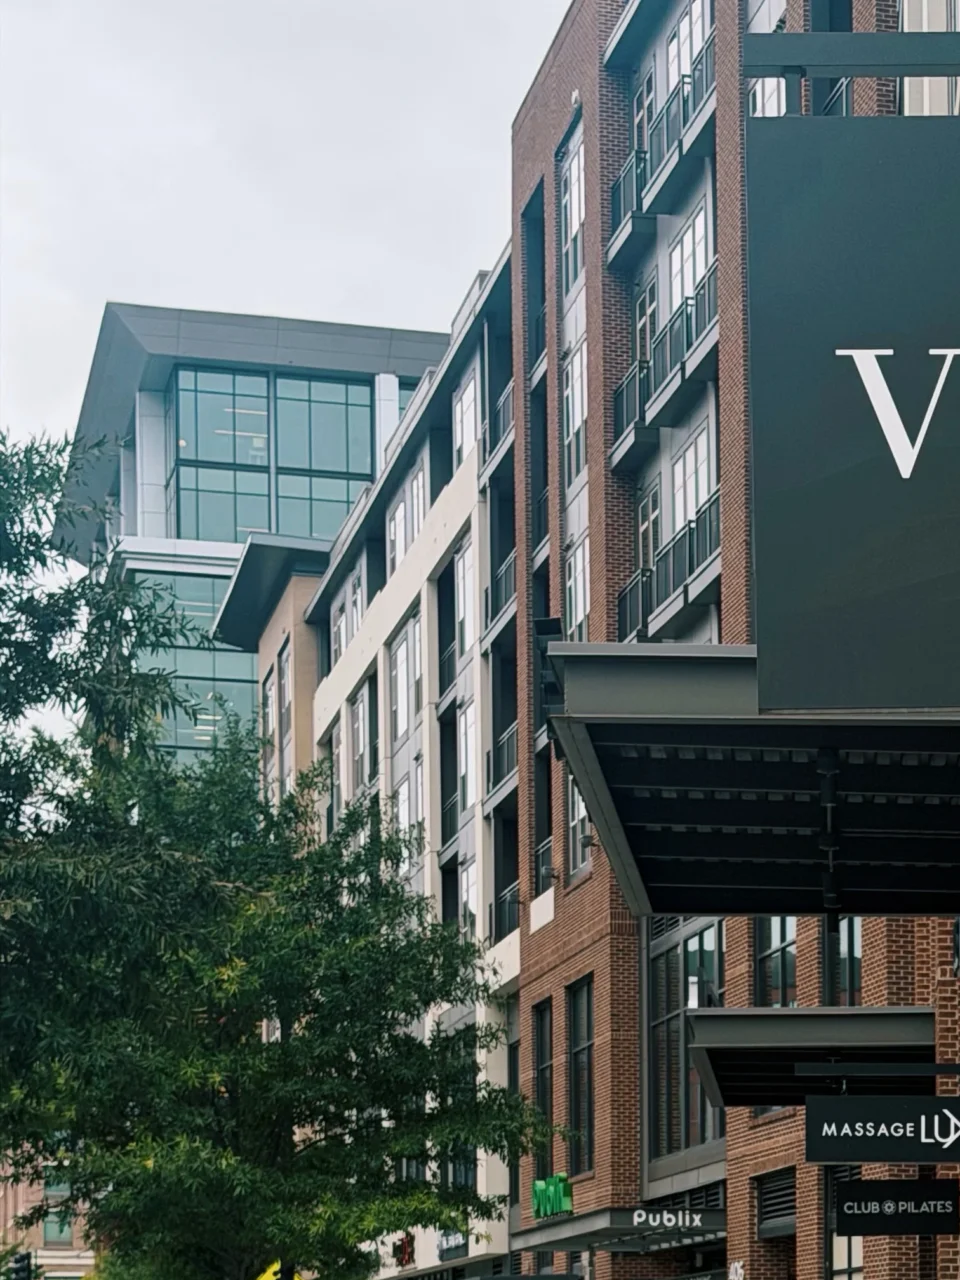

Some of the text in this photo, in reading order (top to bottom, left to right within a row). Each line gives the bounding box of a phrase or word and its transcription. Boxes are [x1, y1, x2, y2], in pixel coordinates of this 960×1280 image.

[822, 1122, 915, 1137] MASSAGE
[843, 1200, 953, 1214] CLUB PILATES
[633, 1209, 702, 1227] Publix
